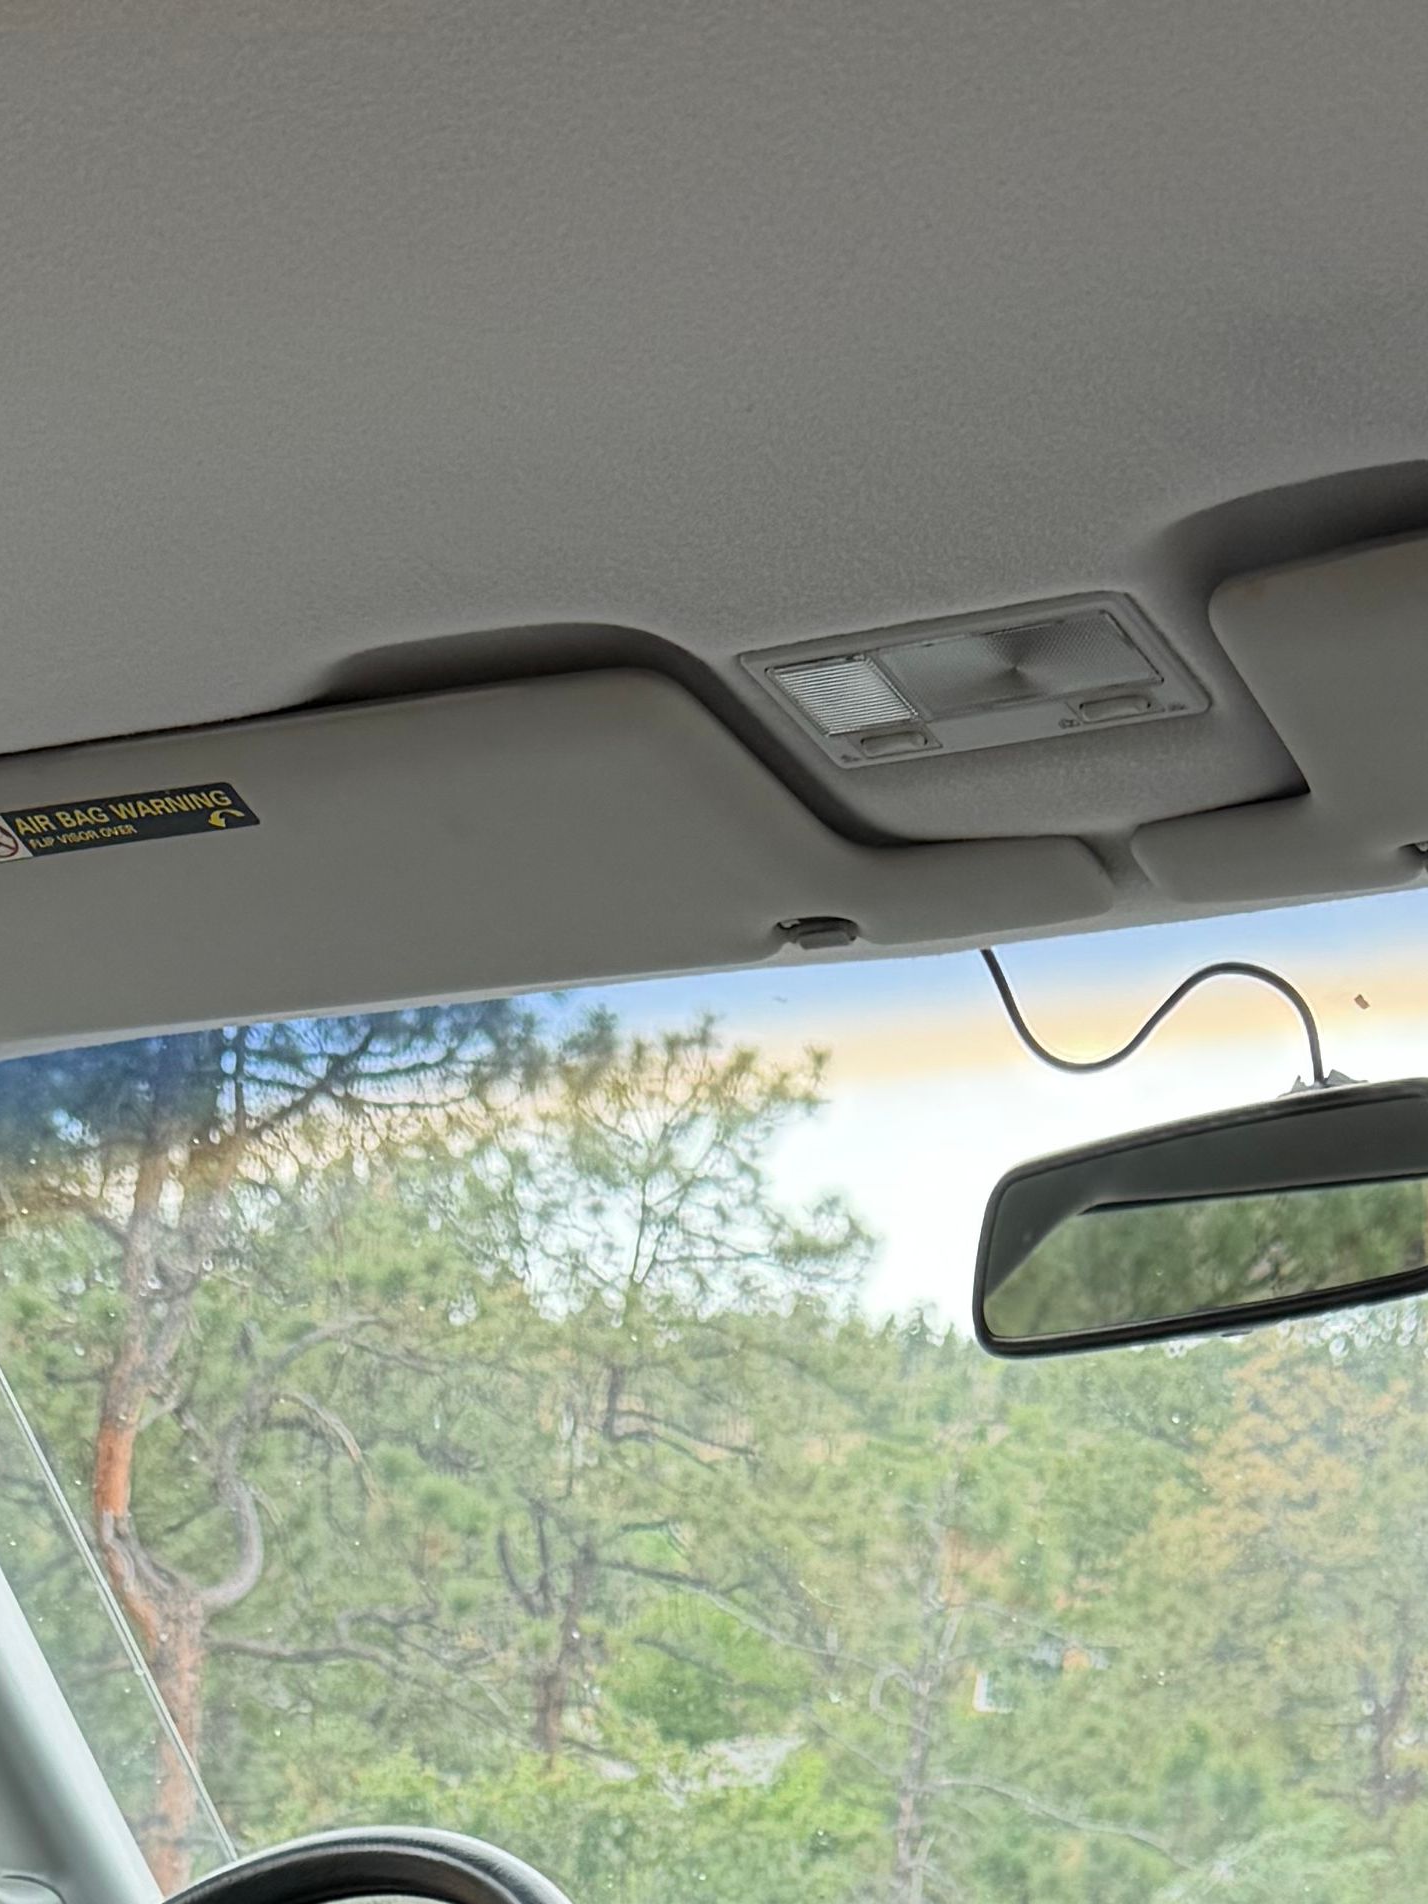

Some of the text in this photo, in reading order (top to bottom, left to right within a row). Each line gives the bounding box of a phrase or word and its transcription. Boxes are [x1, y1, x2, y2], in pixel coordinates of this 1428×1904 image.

[14, 790, 233, 836] AIR BAG WARNING
[28, 824, 138, 849] FLIP VISOR OVER
